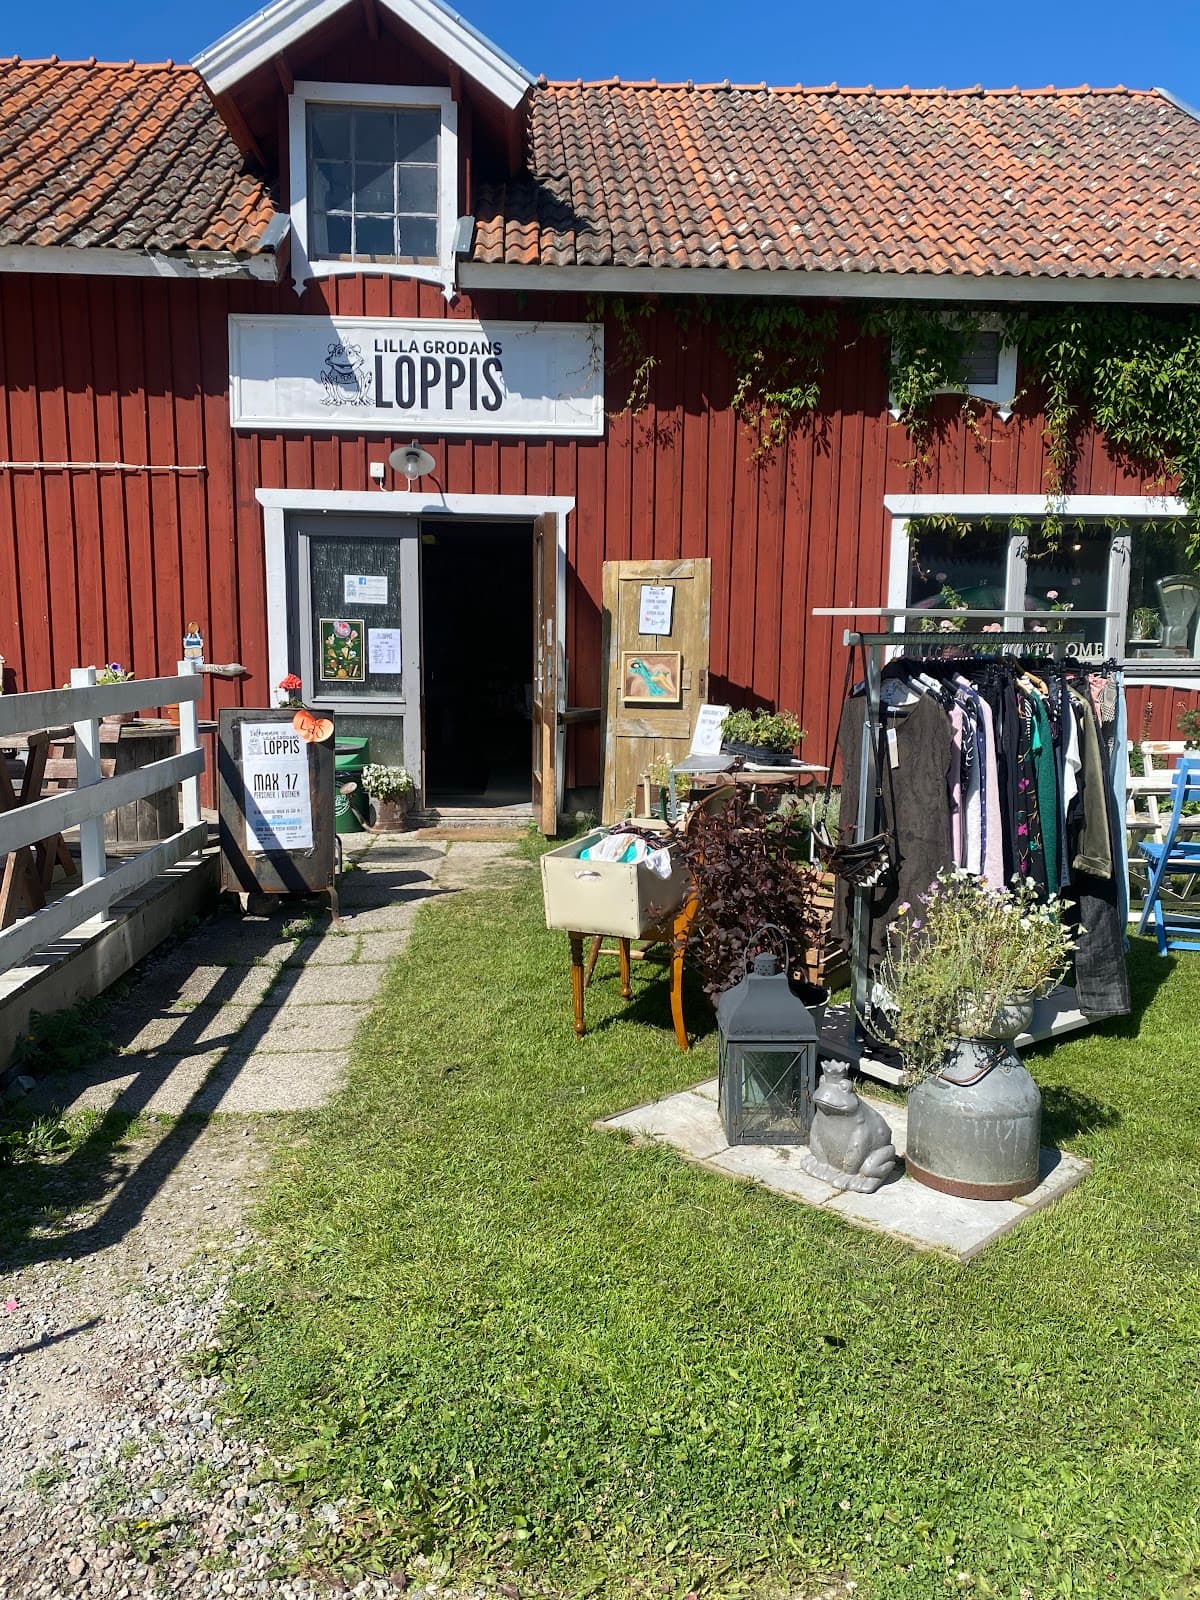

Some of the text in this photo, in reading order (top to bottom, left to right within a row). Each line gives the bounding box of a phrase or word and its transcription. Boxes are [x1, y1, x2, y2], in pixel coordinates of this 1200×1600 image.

[374, 338, 503, 356] LILLA GRODANS
[374, 355, 503, 411] LOPPIS
[263, 739, 300, 755] LOPPIS
[254, 772, 298, 791] MAX 17
